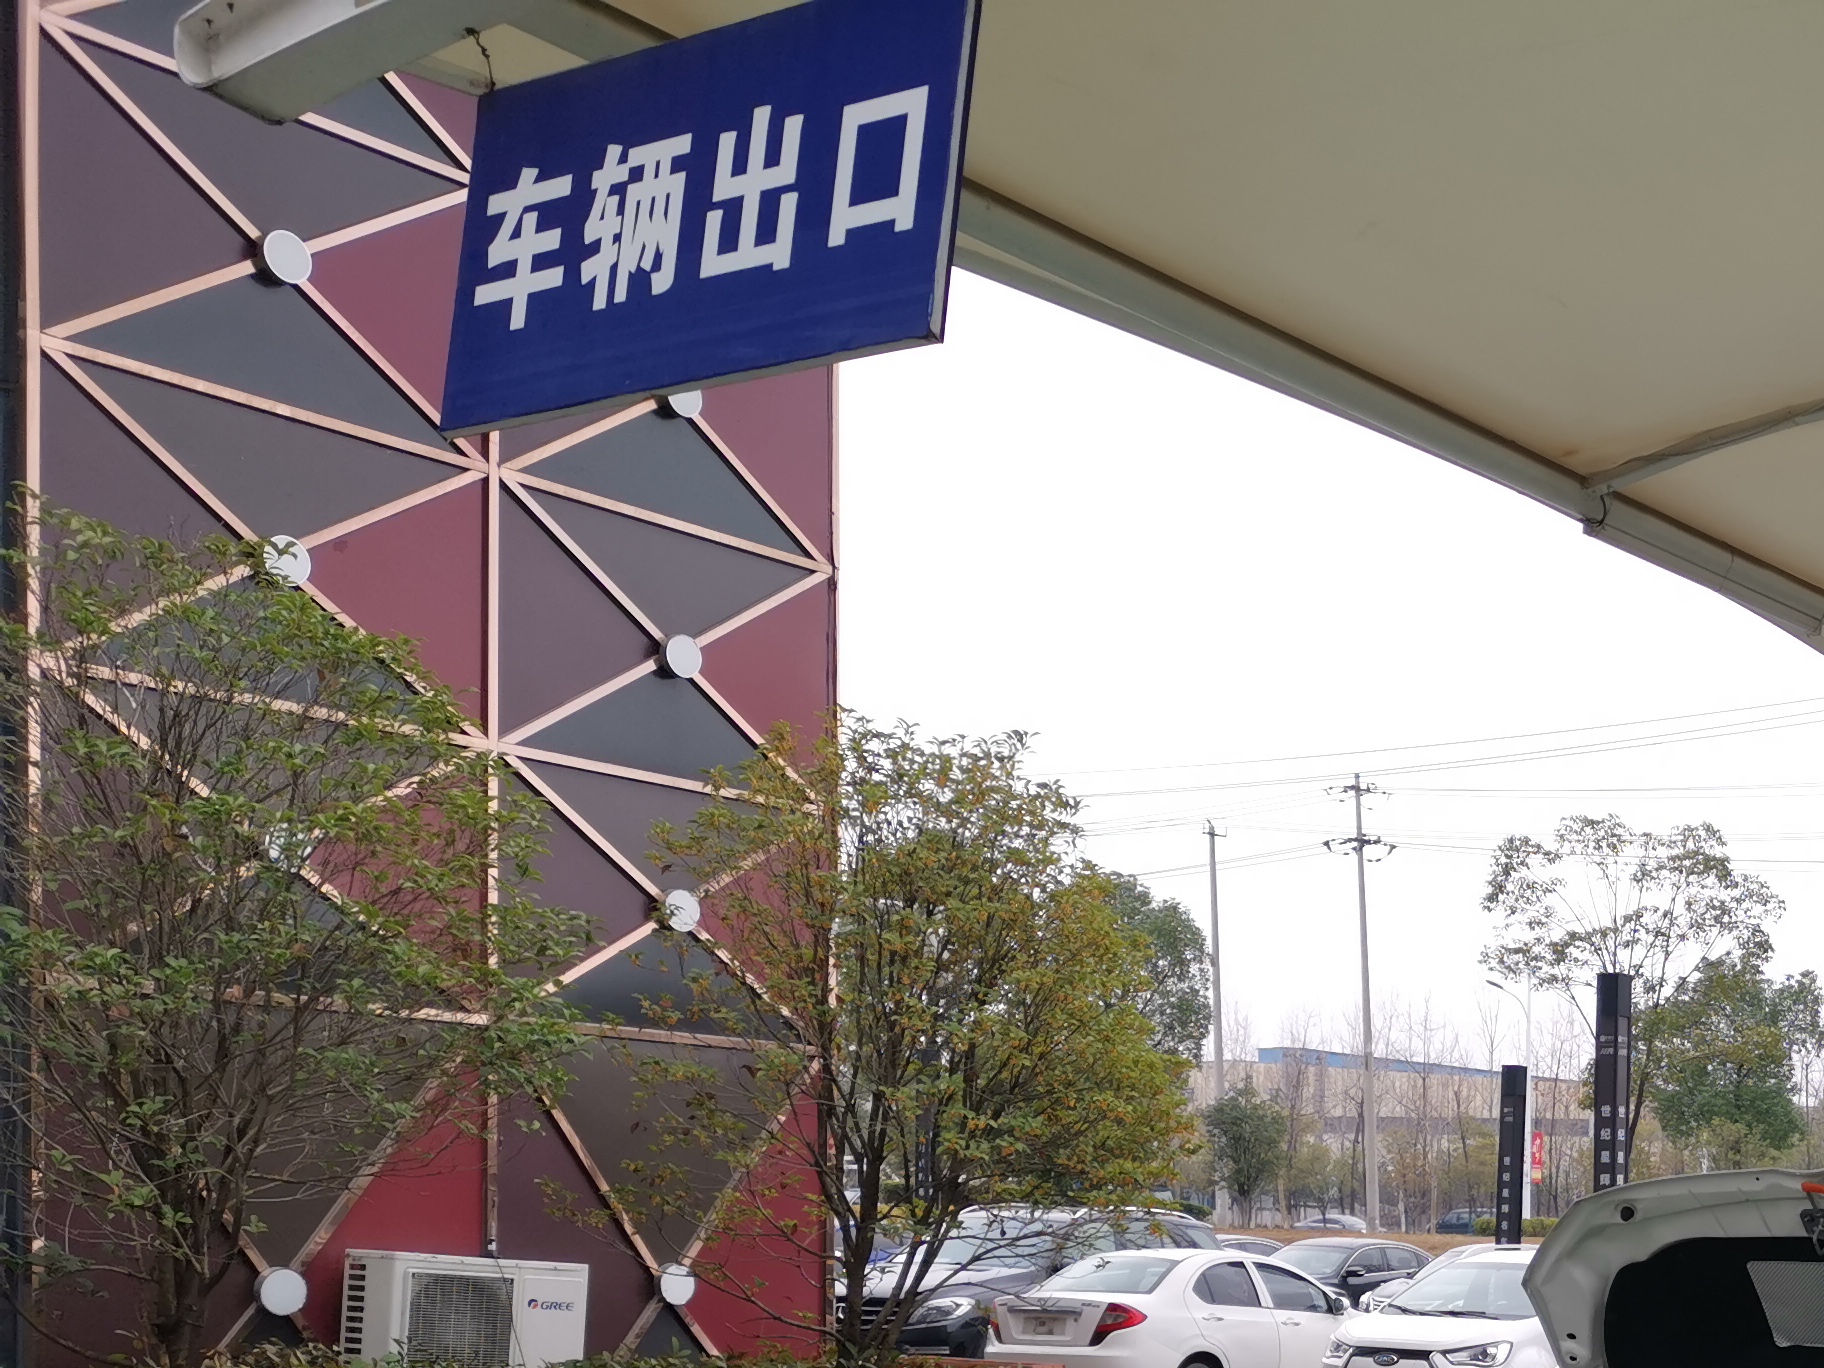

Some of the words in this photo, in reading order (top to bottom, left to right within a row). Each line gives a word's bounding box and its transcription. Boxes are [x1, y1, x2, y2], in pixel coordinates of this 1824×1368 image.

[473, 85, 930, 331] 车辆出口
[540, 1300, 575, 1312] GREE
